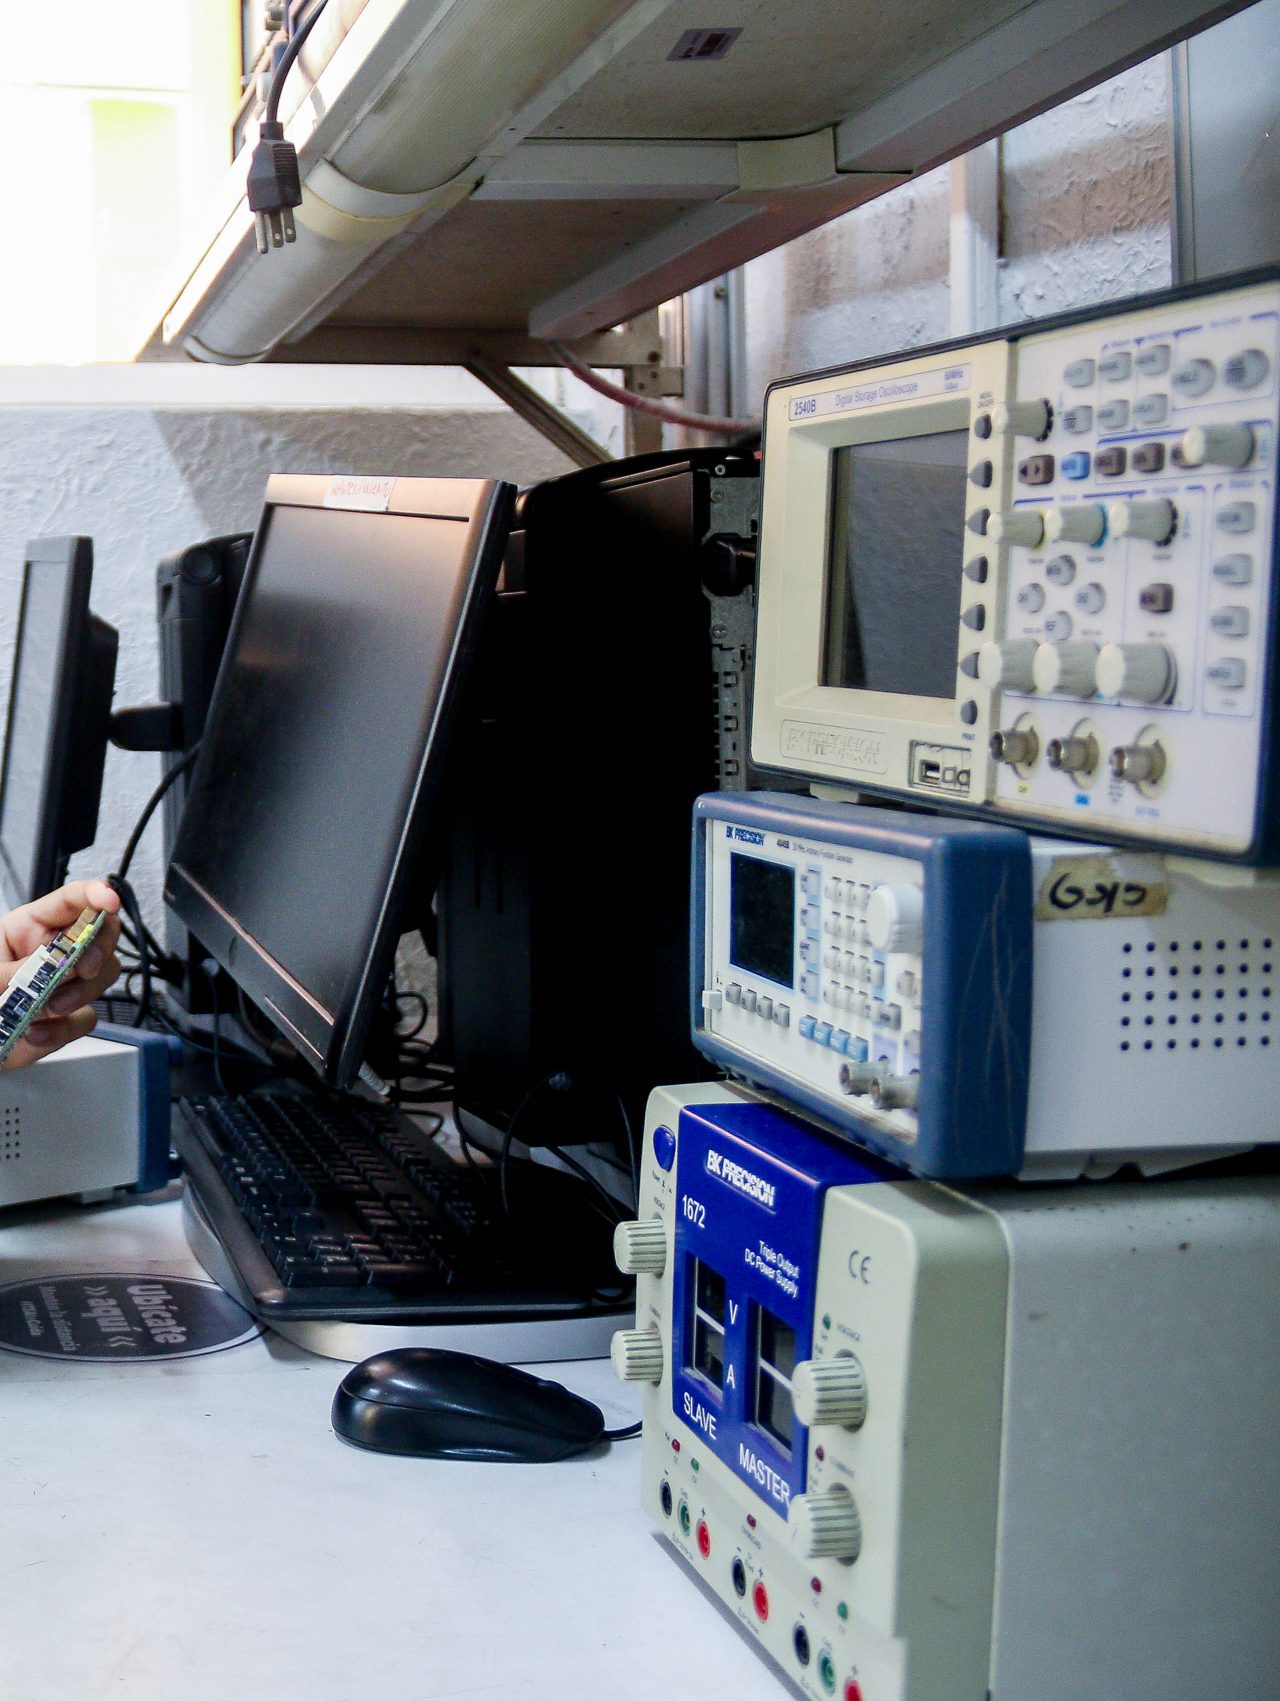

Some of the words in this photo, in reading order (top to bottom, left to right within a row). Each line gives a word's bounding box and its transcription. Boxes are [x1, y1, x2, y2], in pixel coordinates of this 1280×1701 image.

[794, 399, 817, 416] 2540B
[835, 394, 854, 408] Digital
[854, 387, 877, 403] Storage
[878, 381, 919, 399] Oscilloscope
[735, 827, 766, 846] PRECISION
[707, 1149, 723, 1175] BK
[722, 1158, 776, 1207] PRECISION
[682, 1194, 706, 1229] 1672
[744, 1248, 756, 1267] DC
[755, 1257, 776, 1279] Power
[775, 1270, 799, 1299] Supply
[759, 1240, 777, 1263] Triple
[776, 1253, 800, 1279] Output
[849, 1249, 873, 1285] CE
[80, 1297, 142, 1333] aquí
[126, 1284, 187, 1344] Ubícate
[729, 1299, 738, 1325] V
[726, 1364, 736, 1389] A
[683, 1391, 718, 1441] SLAVE
[739, 1442, 791, 1508] MASTER
